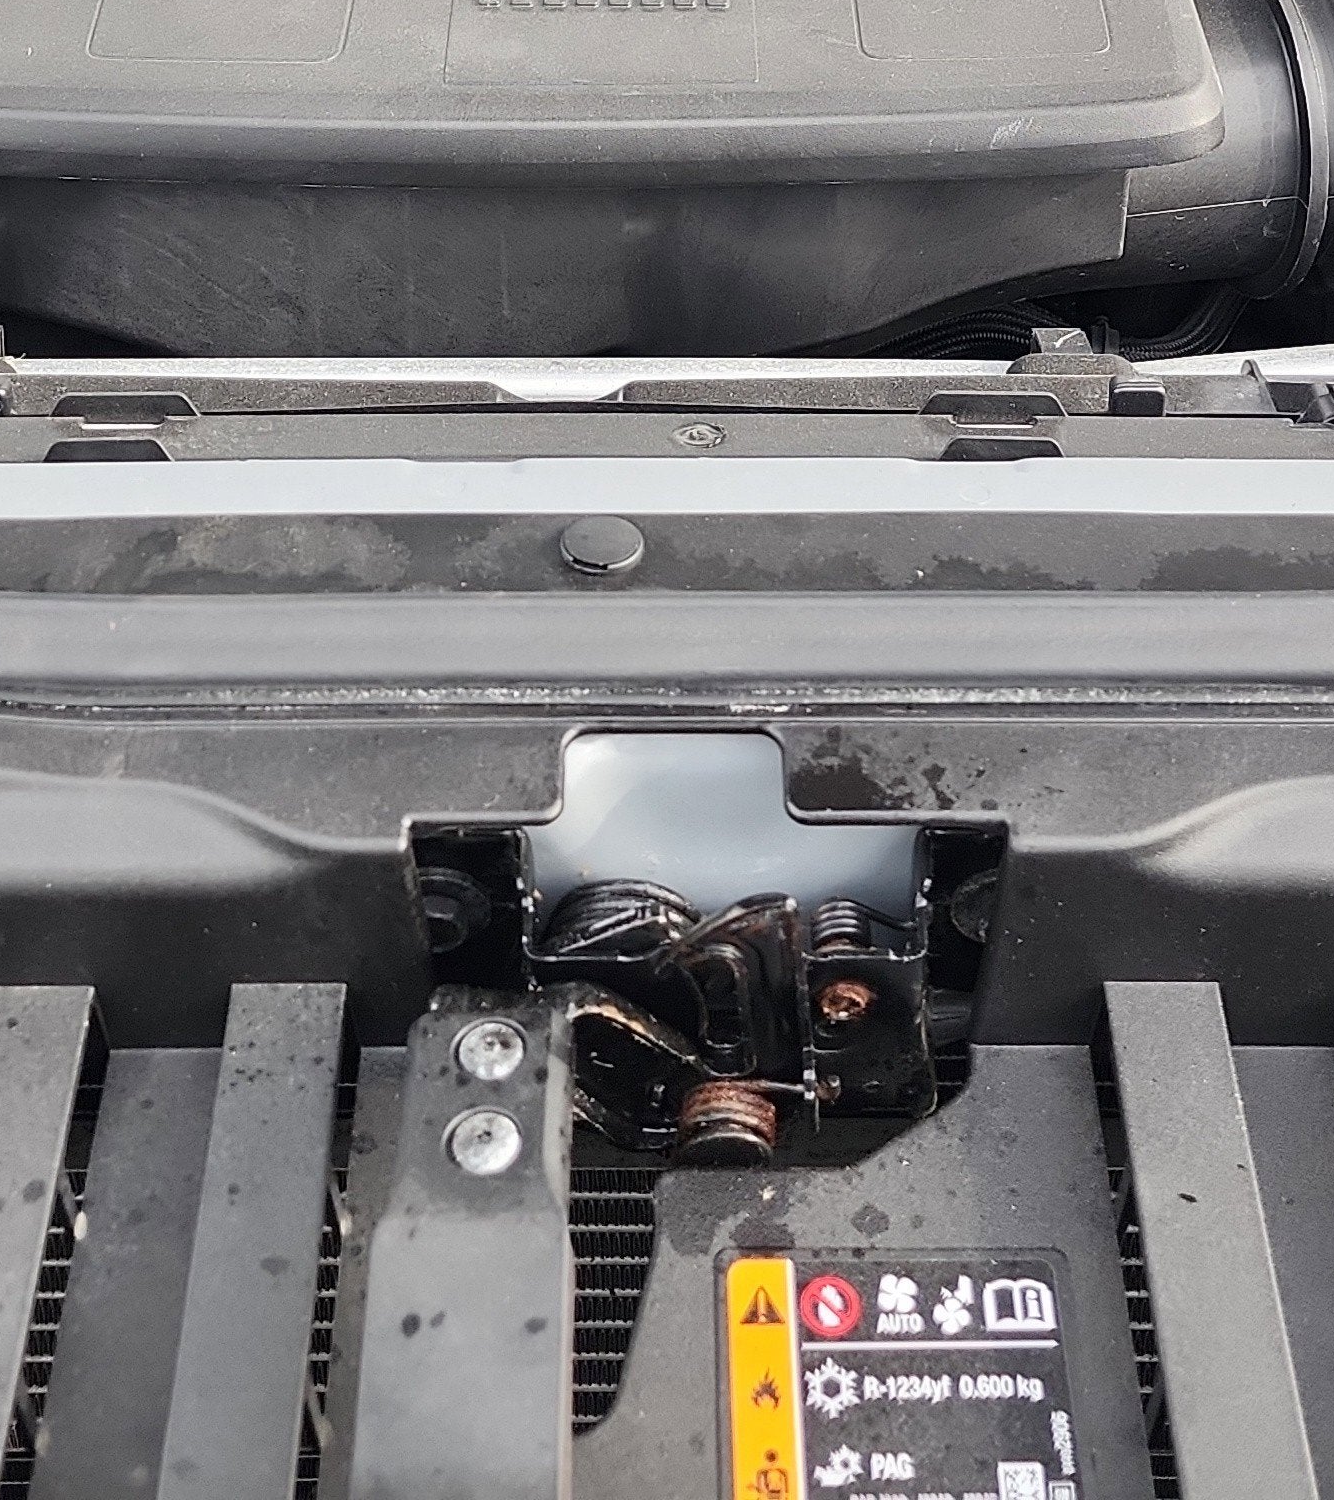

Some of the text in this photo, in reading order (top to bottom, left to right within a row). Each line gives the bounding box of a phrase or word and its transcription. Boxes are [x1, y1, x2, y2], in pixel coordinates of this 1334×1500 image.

[876, 1312, 926, 1335] AUTO
[863, 1373, 1045, 1405] R-1234yf 0.600 kg
[870, 1452, 916, 1481] PAG
